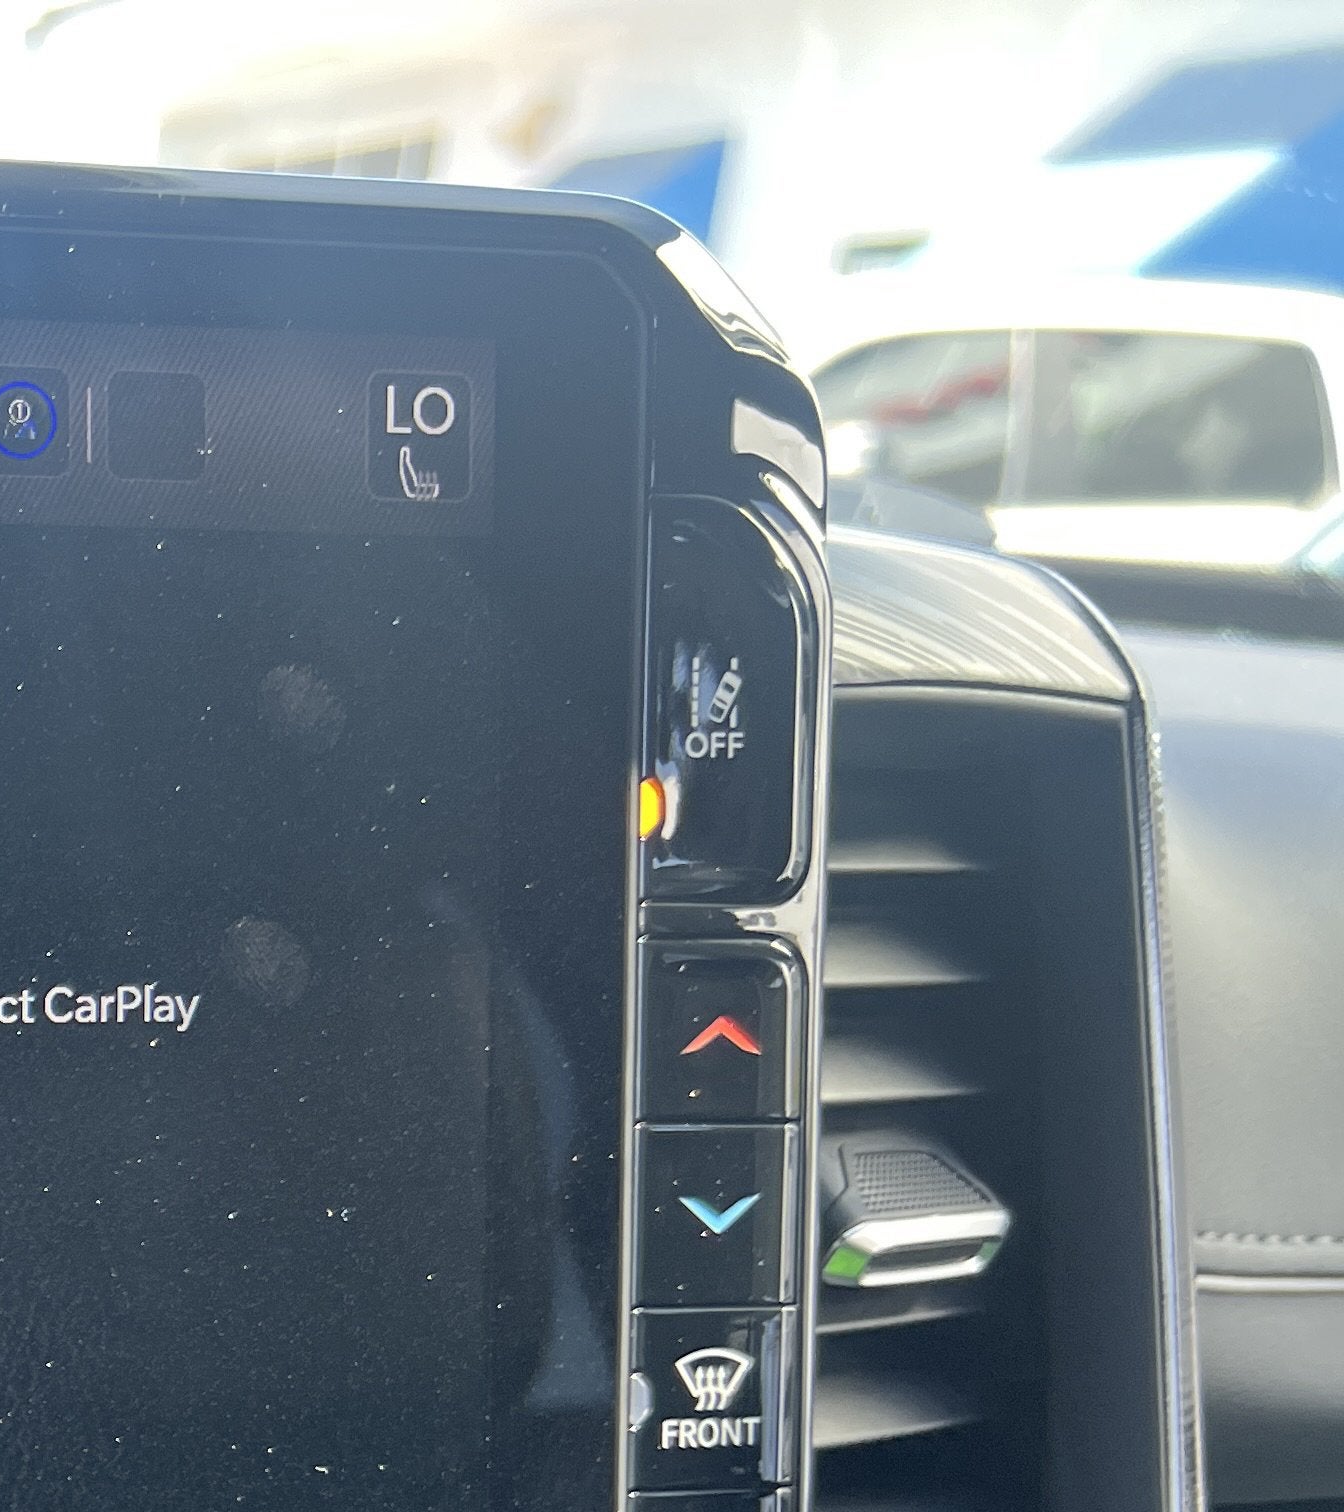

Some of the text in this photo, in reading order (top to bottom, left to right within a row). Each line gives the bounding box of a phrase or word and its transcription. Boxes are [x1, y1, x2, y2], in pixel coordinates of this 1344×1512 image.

[385, 385, 455, 436] LO
[684, 731, 744, 759] OFF
[43, 984, 202, 1032] CarPlay
[661, 1416, 761, 1448] FRONT
